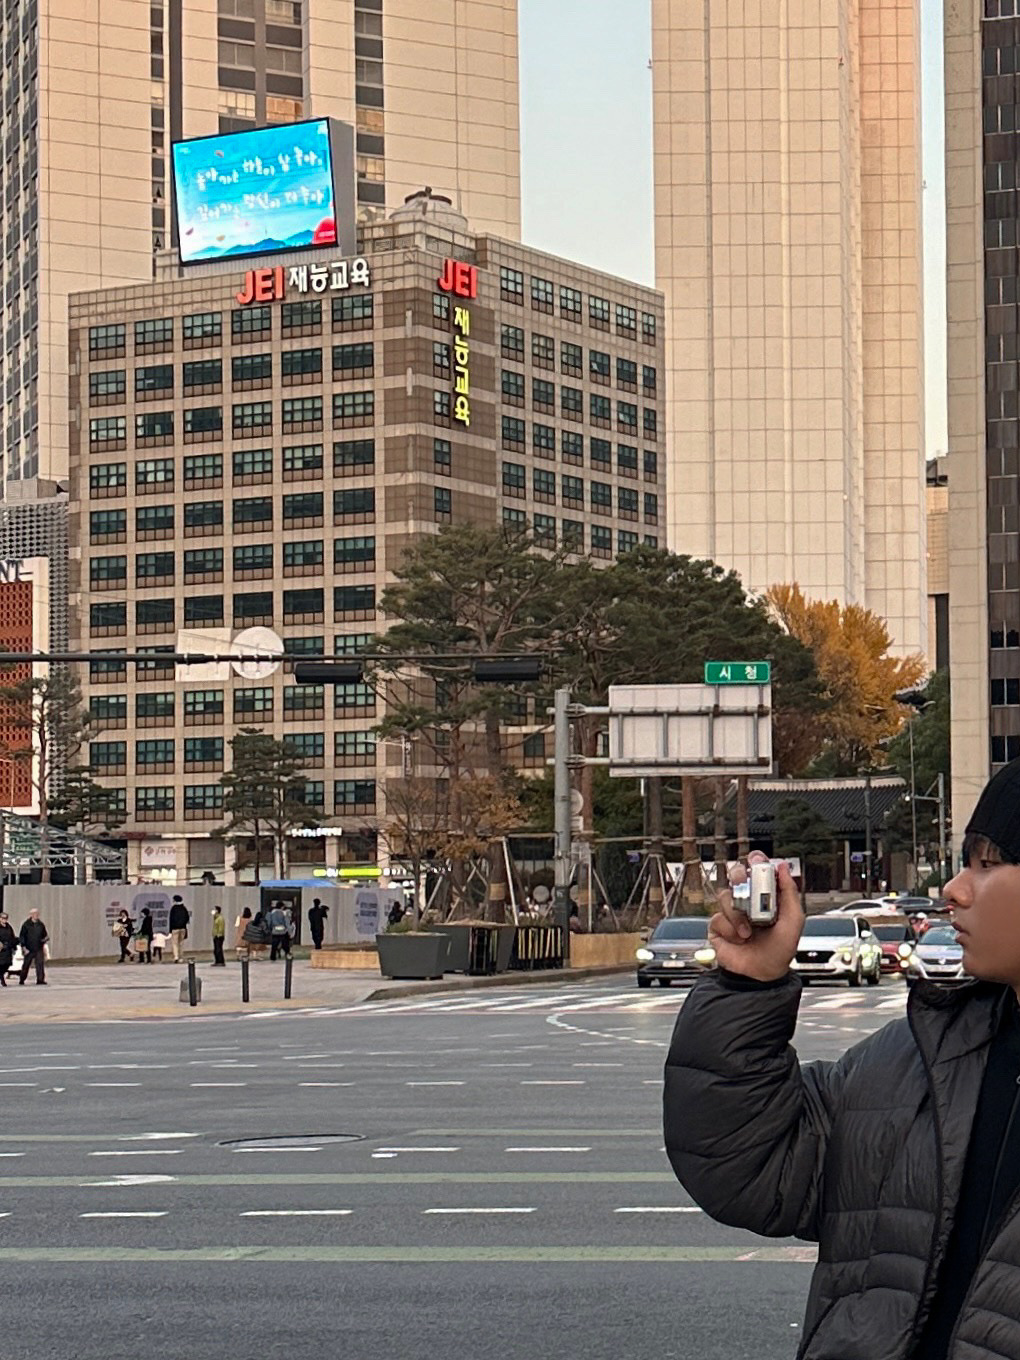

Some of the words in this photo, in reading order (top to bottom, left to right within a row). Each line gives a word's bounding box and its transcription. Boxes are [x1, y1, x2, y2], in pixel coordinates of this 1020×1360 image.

[236, 265, 286, 305] JEI
[288, 257, 370, 293] 재능교육
[437, 258, 478, 299] JEI
[453, 306, 470, 427] 재능교육
